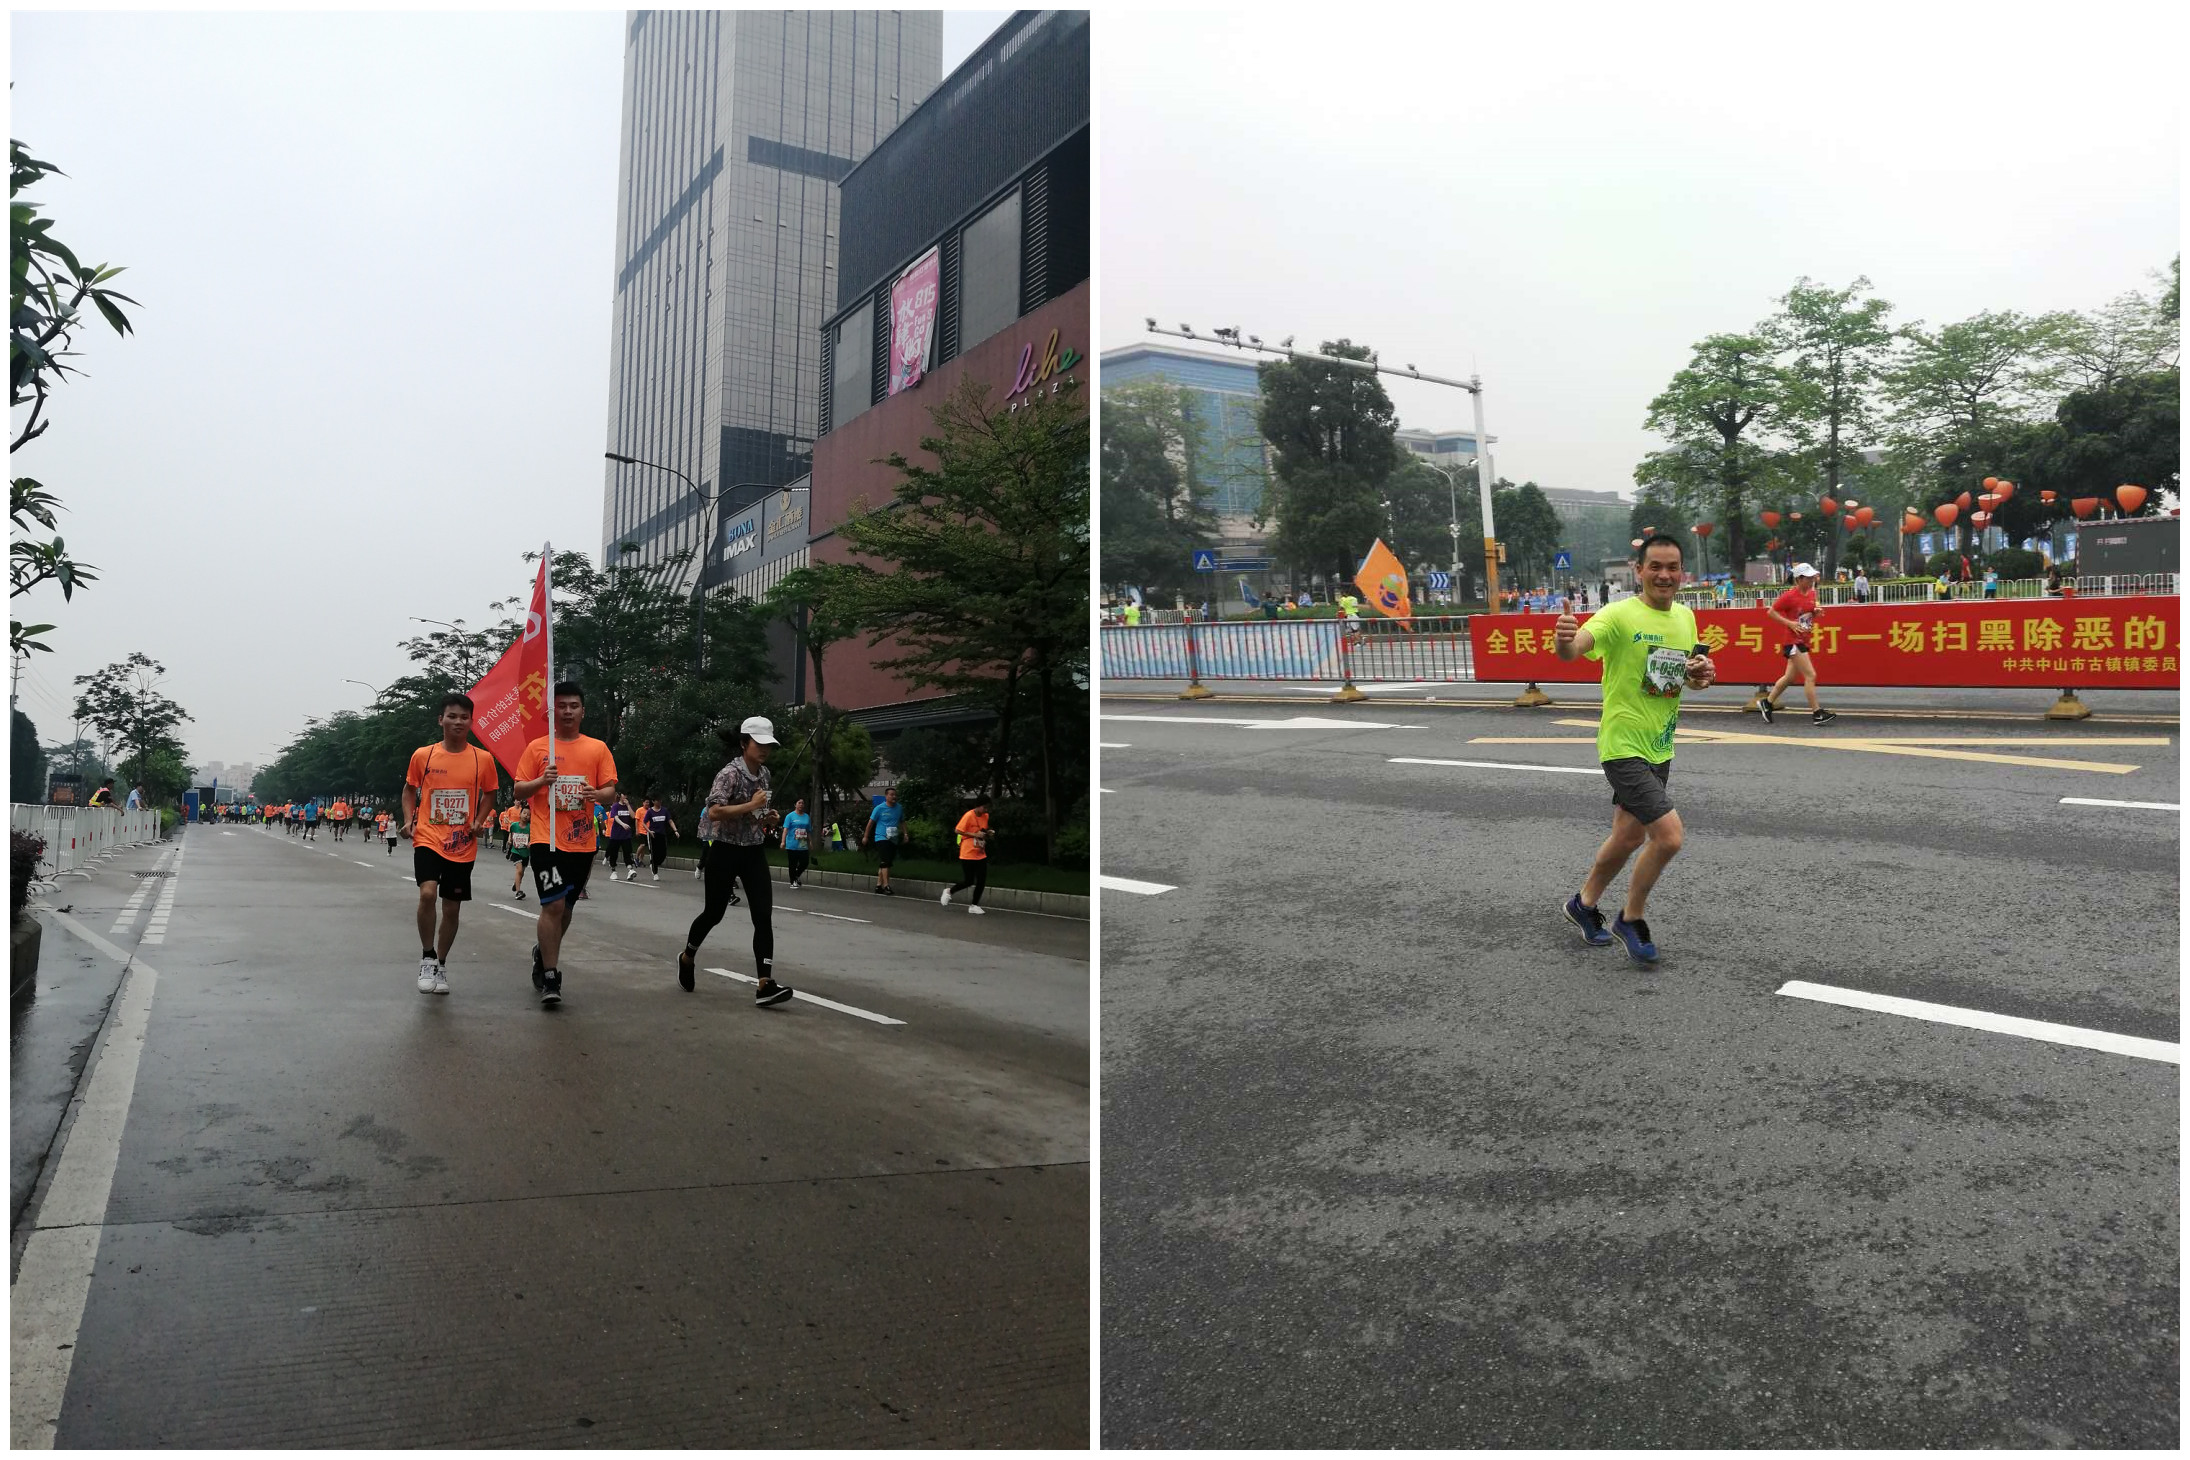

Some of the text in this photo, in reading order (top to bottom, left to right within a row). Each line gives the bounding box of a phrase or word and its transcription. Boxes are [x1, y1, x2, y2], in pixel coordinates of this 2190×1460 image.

[914, 283, 937, 309] 815
[723, 534, 757, 562] IMAX
[435, 797, 465, 809] E-0277
[539, 866, 564, 892] 24
